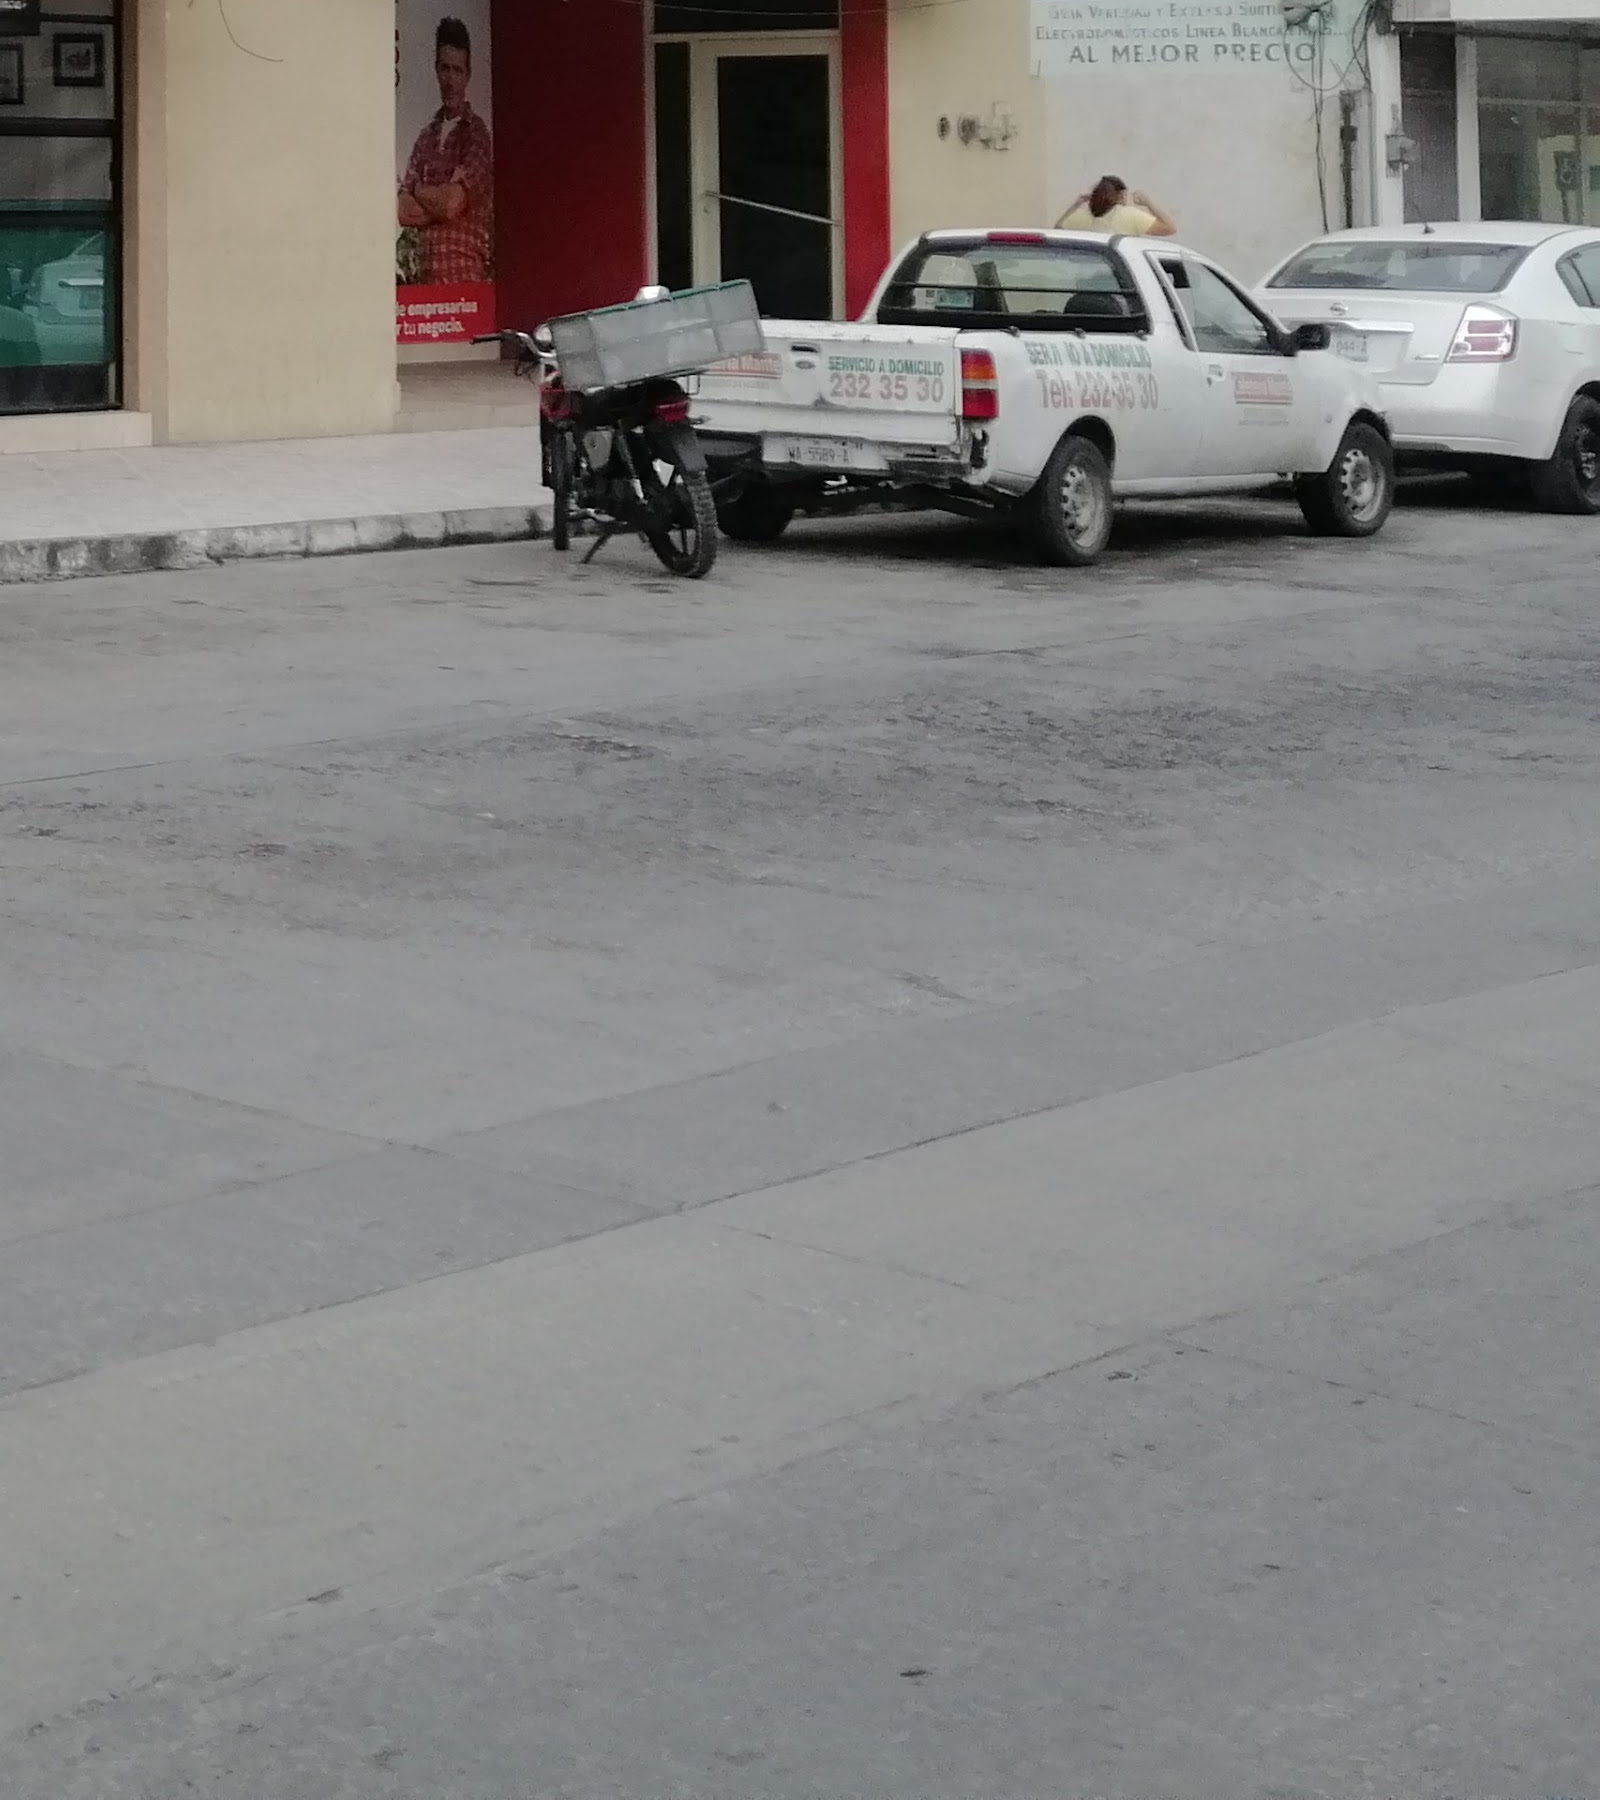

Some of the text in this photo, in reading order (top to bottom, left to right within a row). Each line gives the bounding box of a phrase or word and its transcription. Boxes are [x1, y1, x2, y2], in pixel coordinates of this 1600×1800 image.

[1068, 45, 1100, 64] AL
[1112, 44, 1199, 63] MEJOR
[828, 355, 876, 373] SERVICIO
[888, 358, 945, 377] DOMICILIO
[829, 372, 945, 403] 232 35 30
